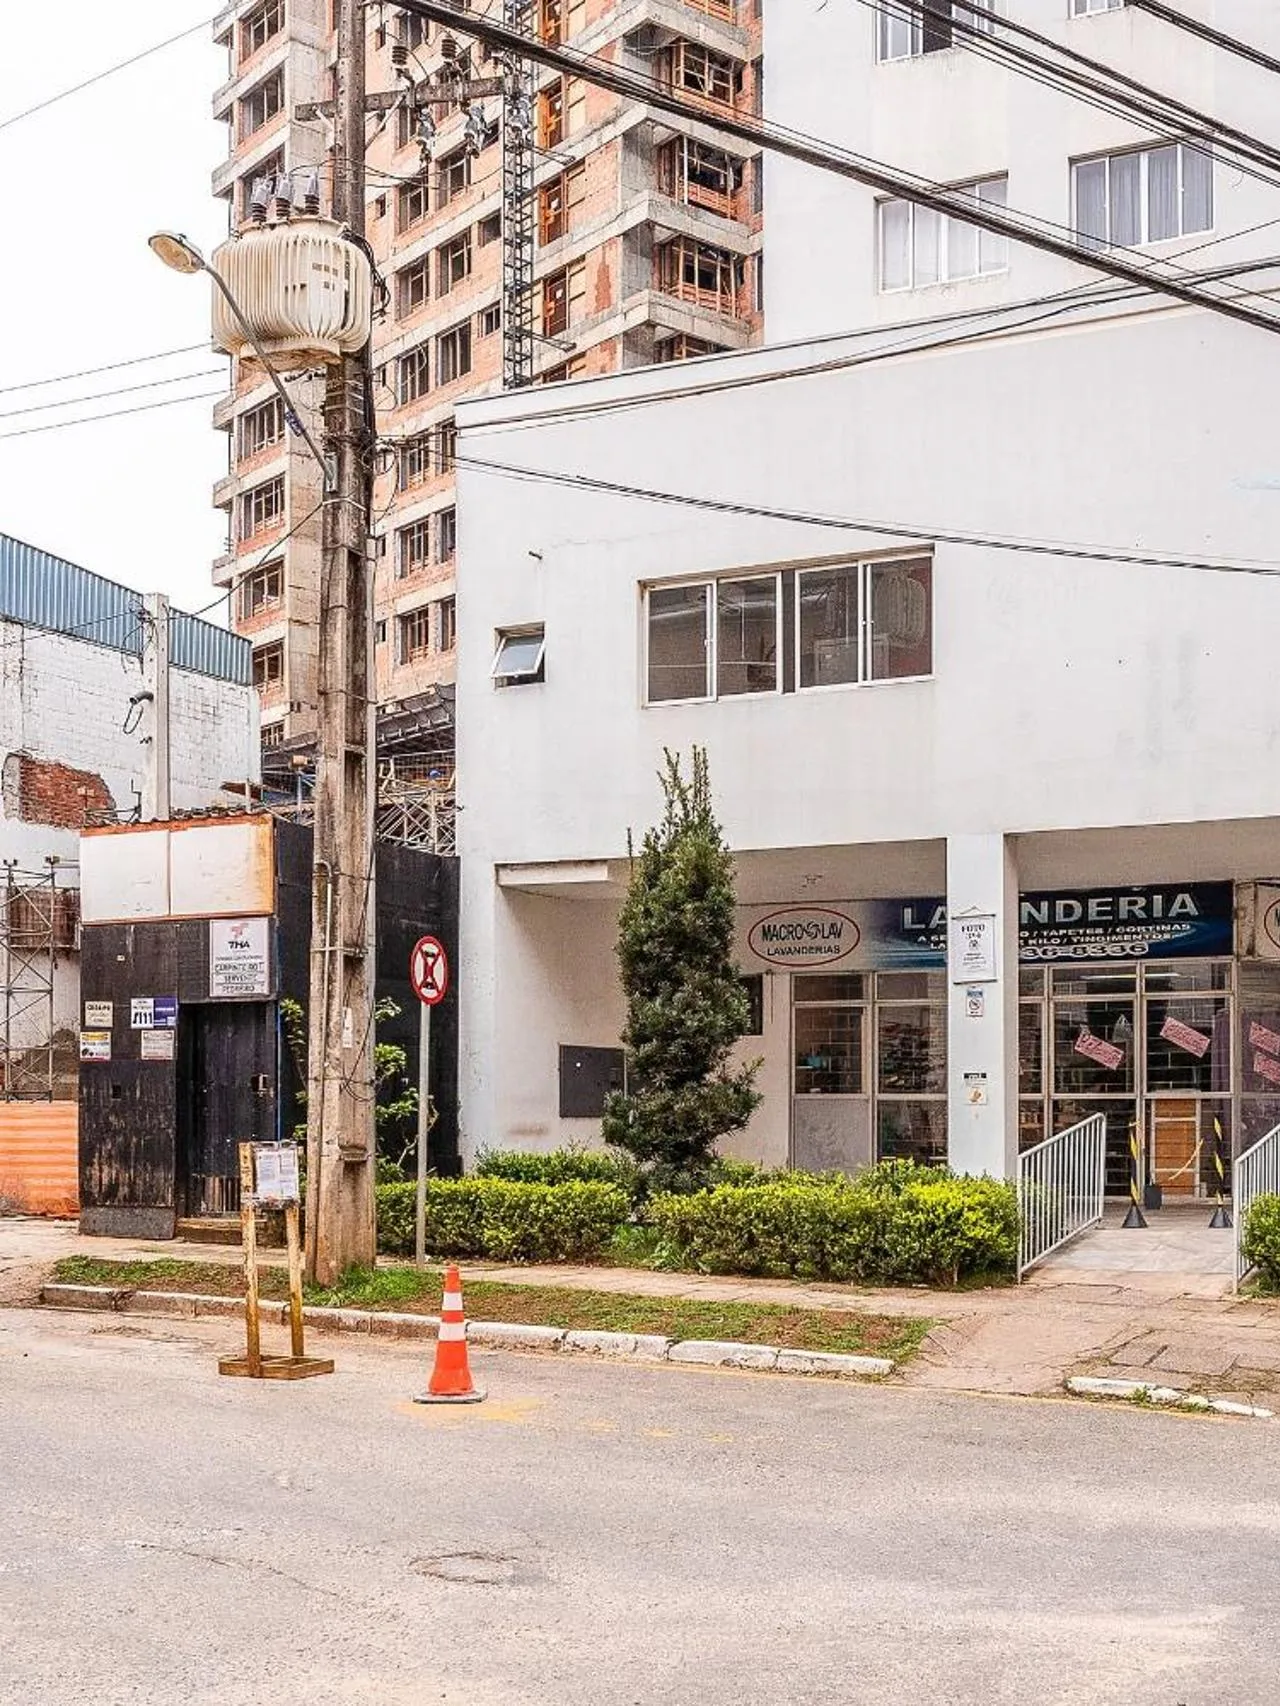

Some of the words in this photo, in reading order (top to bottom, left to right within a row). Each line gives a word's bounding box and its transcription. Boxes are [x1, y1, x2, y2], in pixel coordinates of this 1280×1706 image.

[1042, 927, 1104, 936] TAPETES
[1116, 923, 1191, 933] CORTINAS
[766, 946, 840, 956] LAVANDERIAS
